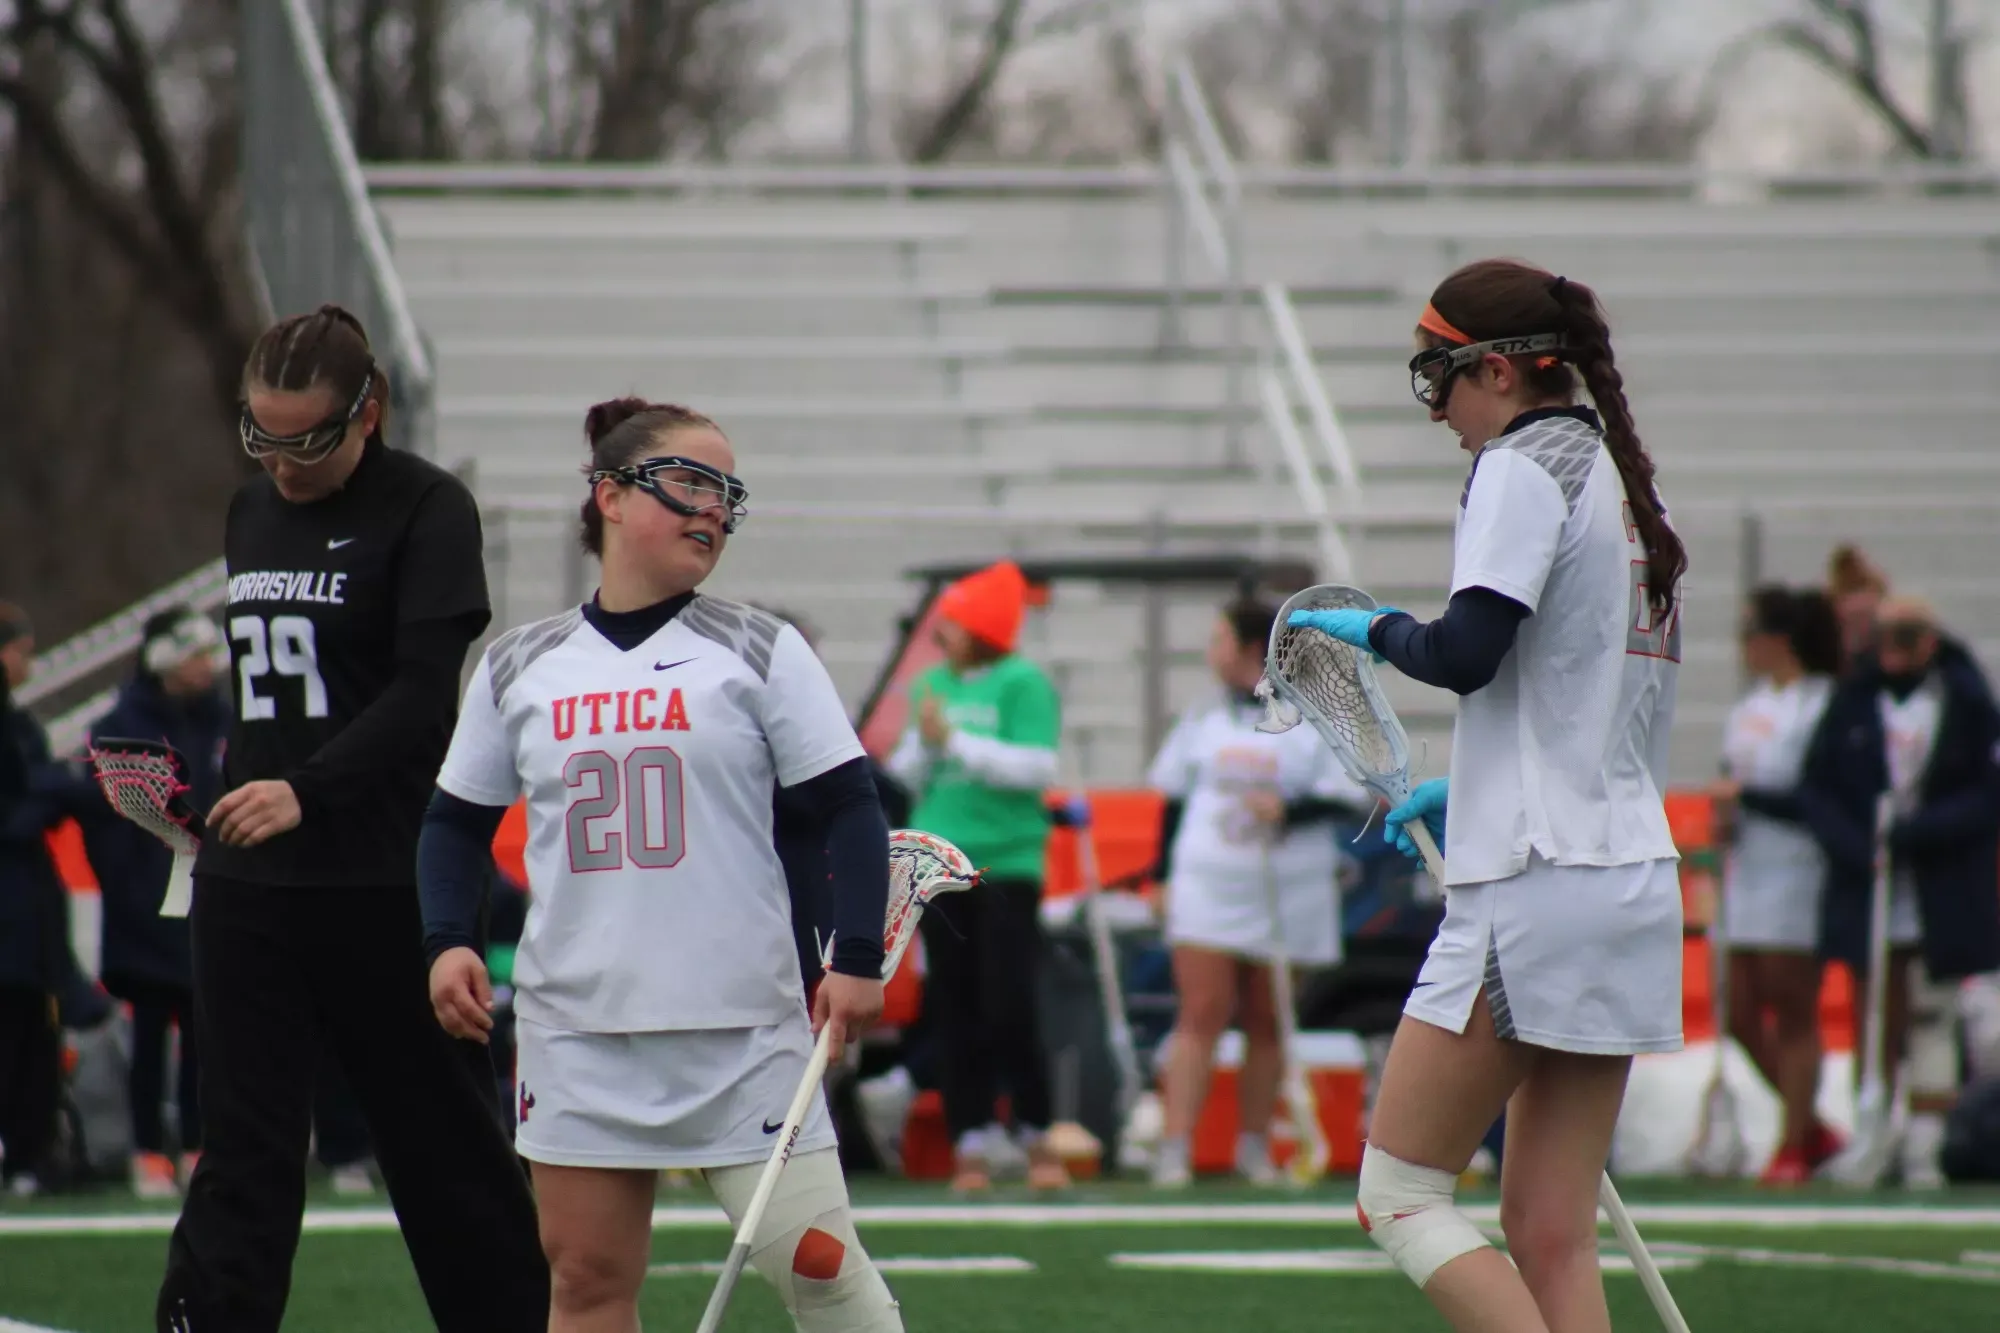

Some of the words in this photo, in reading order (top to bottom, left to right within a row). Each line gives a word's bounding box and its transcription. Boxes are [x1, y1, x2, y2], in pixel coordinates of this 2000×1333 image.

[1491, 338, 1532, 354] STX
[228, 571, 347, 605] MORRISVILLE
[230, 615, 328, 721] 29
[551, 688, 691, 741] UTICA
[562, 746, 686, 873] 20
